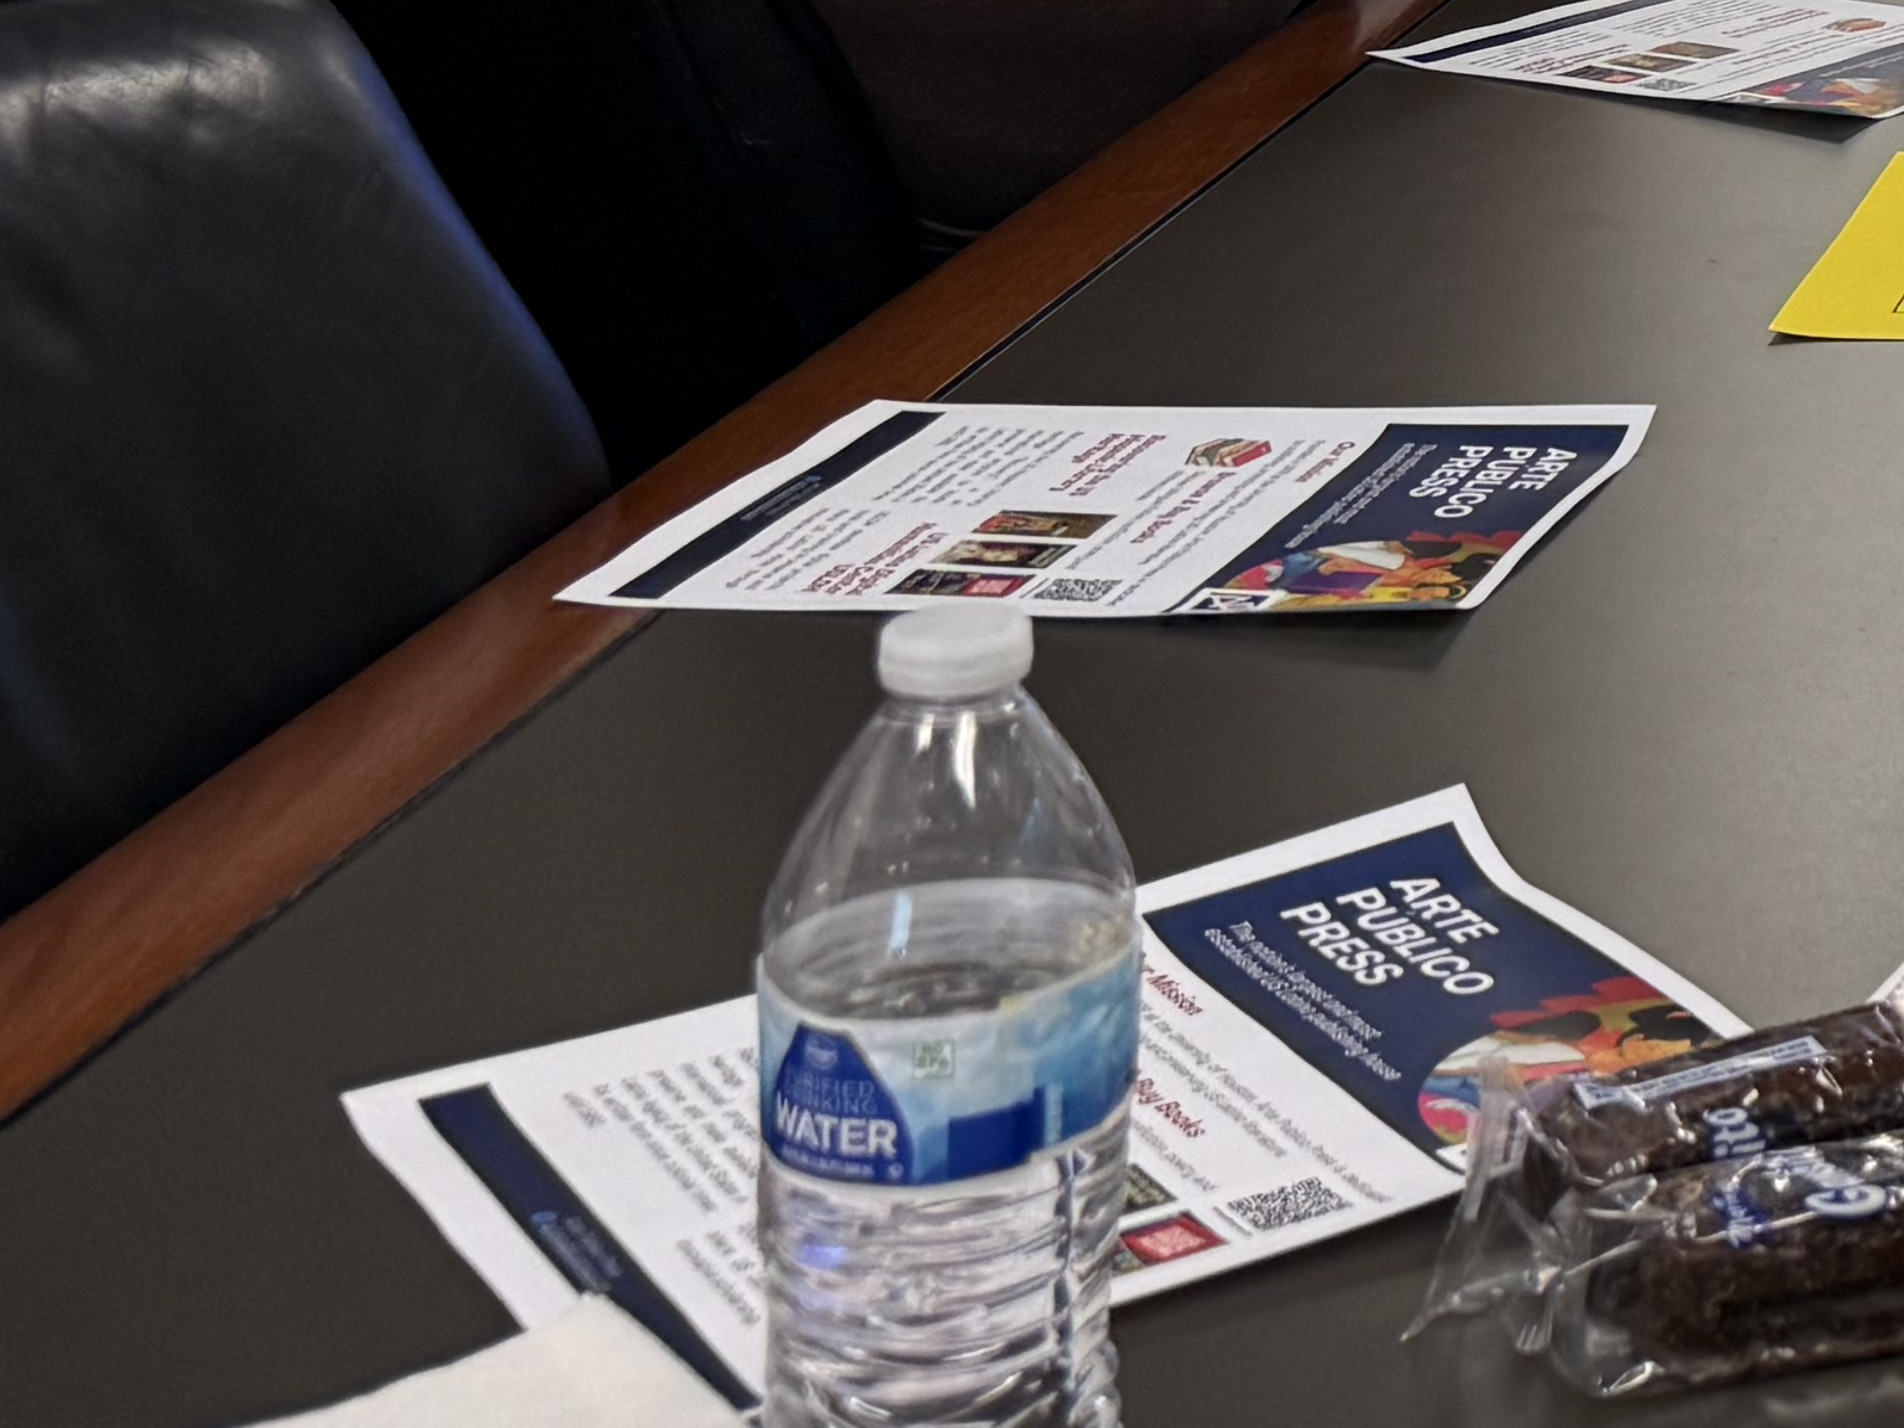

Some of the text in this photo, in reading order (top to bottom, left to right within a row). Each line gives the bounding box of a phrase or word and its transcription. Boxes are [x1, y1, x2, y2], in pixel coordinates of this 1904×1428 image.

[1408, 445, 1494, 498] PRESS
[1508, 447, 1578, 491] ARTE
[1280, 902, 1404, 986] PRESS
[1389, 877, 1500, 944] ARTE
[776, 1091, 897, 1158] WATER
